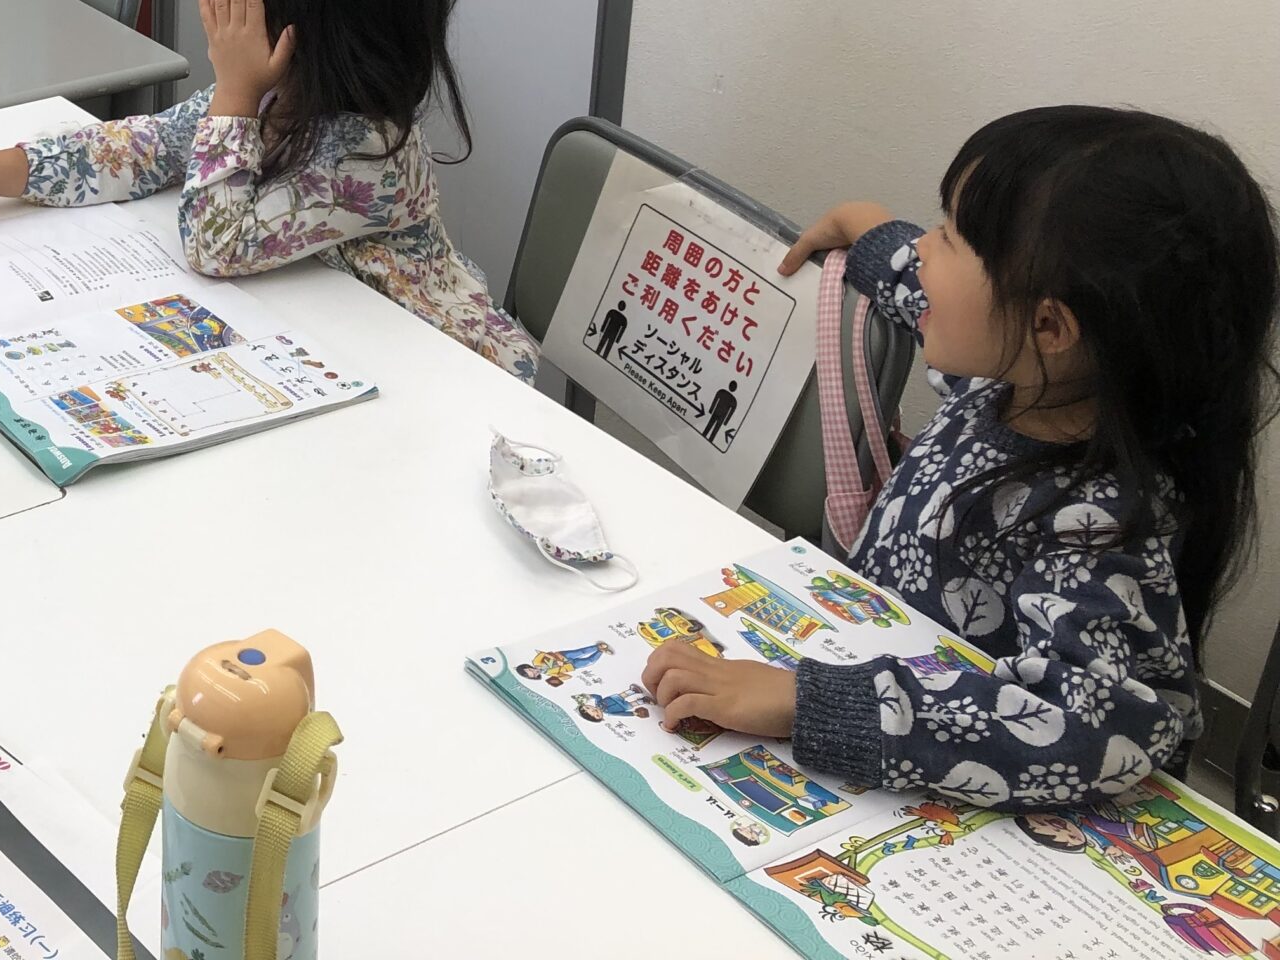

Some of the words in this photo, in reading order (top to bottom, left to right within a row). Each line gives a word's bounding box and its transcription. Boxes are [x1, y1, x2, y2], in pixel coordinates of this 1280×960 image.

[663, 229, 761, 305] 周囲の方と
[641, 250, 758, 341] 距離をあけて
[622, 273, 753, 377] ご利用ください
[644, 324, 703, 375] ソーシャル
[623, 363, 647, 387] Please
[647, 381, 667, 400] Keep
[666, 395, 688, 416] Apart
[631, 340, 702, 401] ディスタンス
[676, 771, 698, 790] Let's
[703, 793, 737, 820] 认一认
[862, 930, 894, 955] 校
